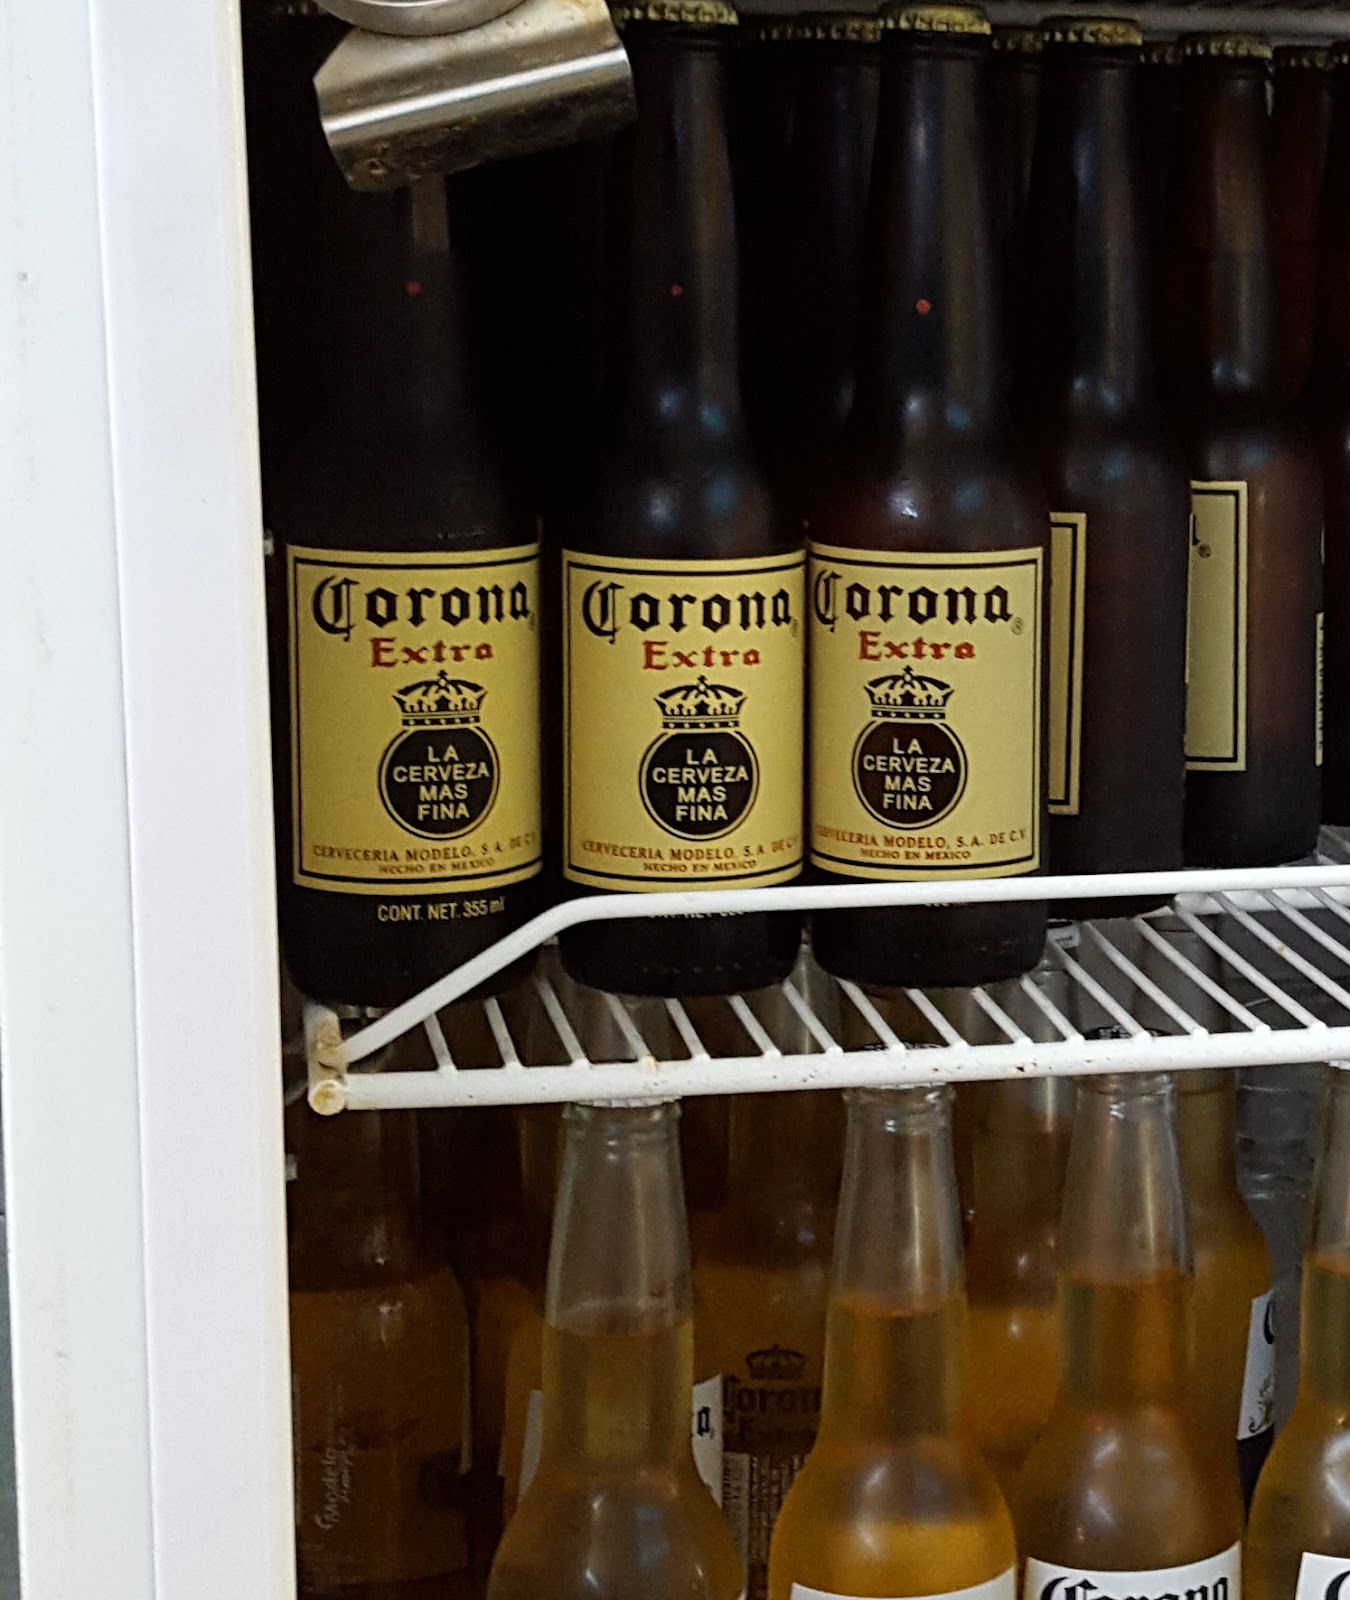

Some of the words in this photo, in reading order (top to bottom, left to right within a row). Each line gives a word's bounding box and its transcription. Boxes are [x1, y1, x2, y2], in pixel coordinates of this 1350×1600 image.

[313, 575, 531, 642] Corona
[814, 569, 1013, 634] Corona
[582, 580, 791, 645] Corona
[369, 636, 494, 668] Extra
[858, 629, 977, 661] Extra
[642, 640, 762, 671] Extra
[427, 745, 459, 763] LA
[892, 737, 924, 755] LA
[686, 748, 719, 765] LA
[863, 754, 956, 775] CERVEZA
[392, 761, 491, 784] CERVEZA
[652, 764, 750, 786] CERVEZA
[419, 784, 469, 802] MAS
[883, 775, 932, 793] MAS
[677, 785, 727, 803] MAS
[882, 793, 934, 811] FINA
[417, 803, 470, 821] FINA
[675, 804, 729, 822] FINA
[990, 833, 1006, 845] DE
[312, 845, 398, 862] CERVECERIA
[582, 840, 664, 861] CERVECERIA
[905, 850, 920, 860] EN
[925, 850, 971, 860] MEXICO
[643, 862, 688, 873] HECHO
[692, 862, 709, 873] EN
[463, 899, 488, 918] 355
